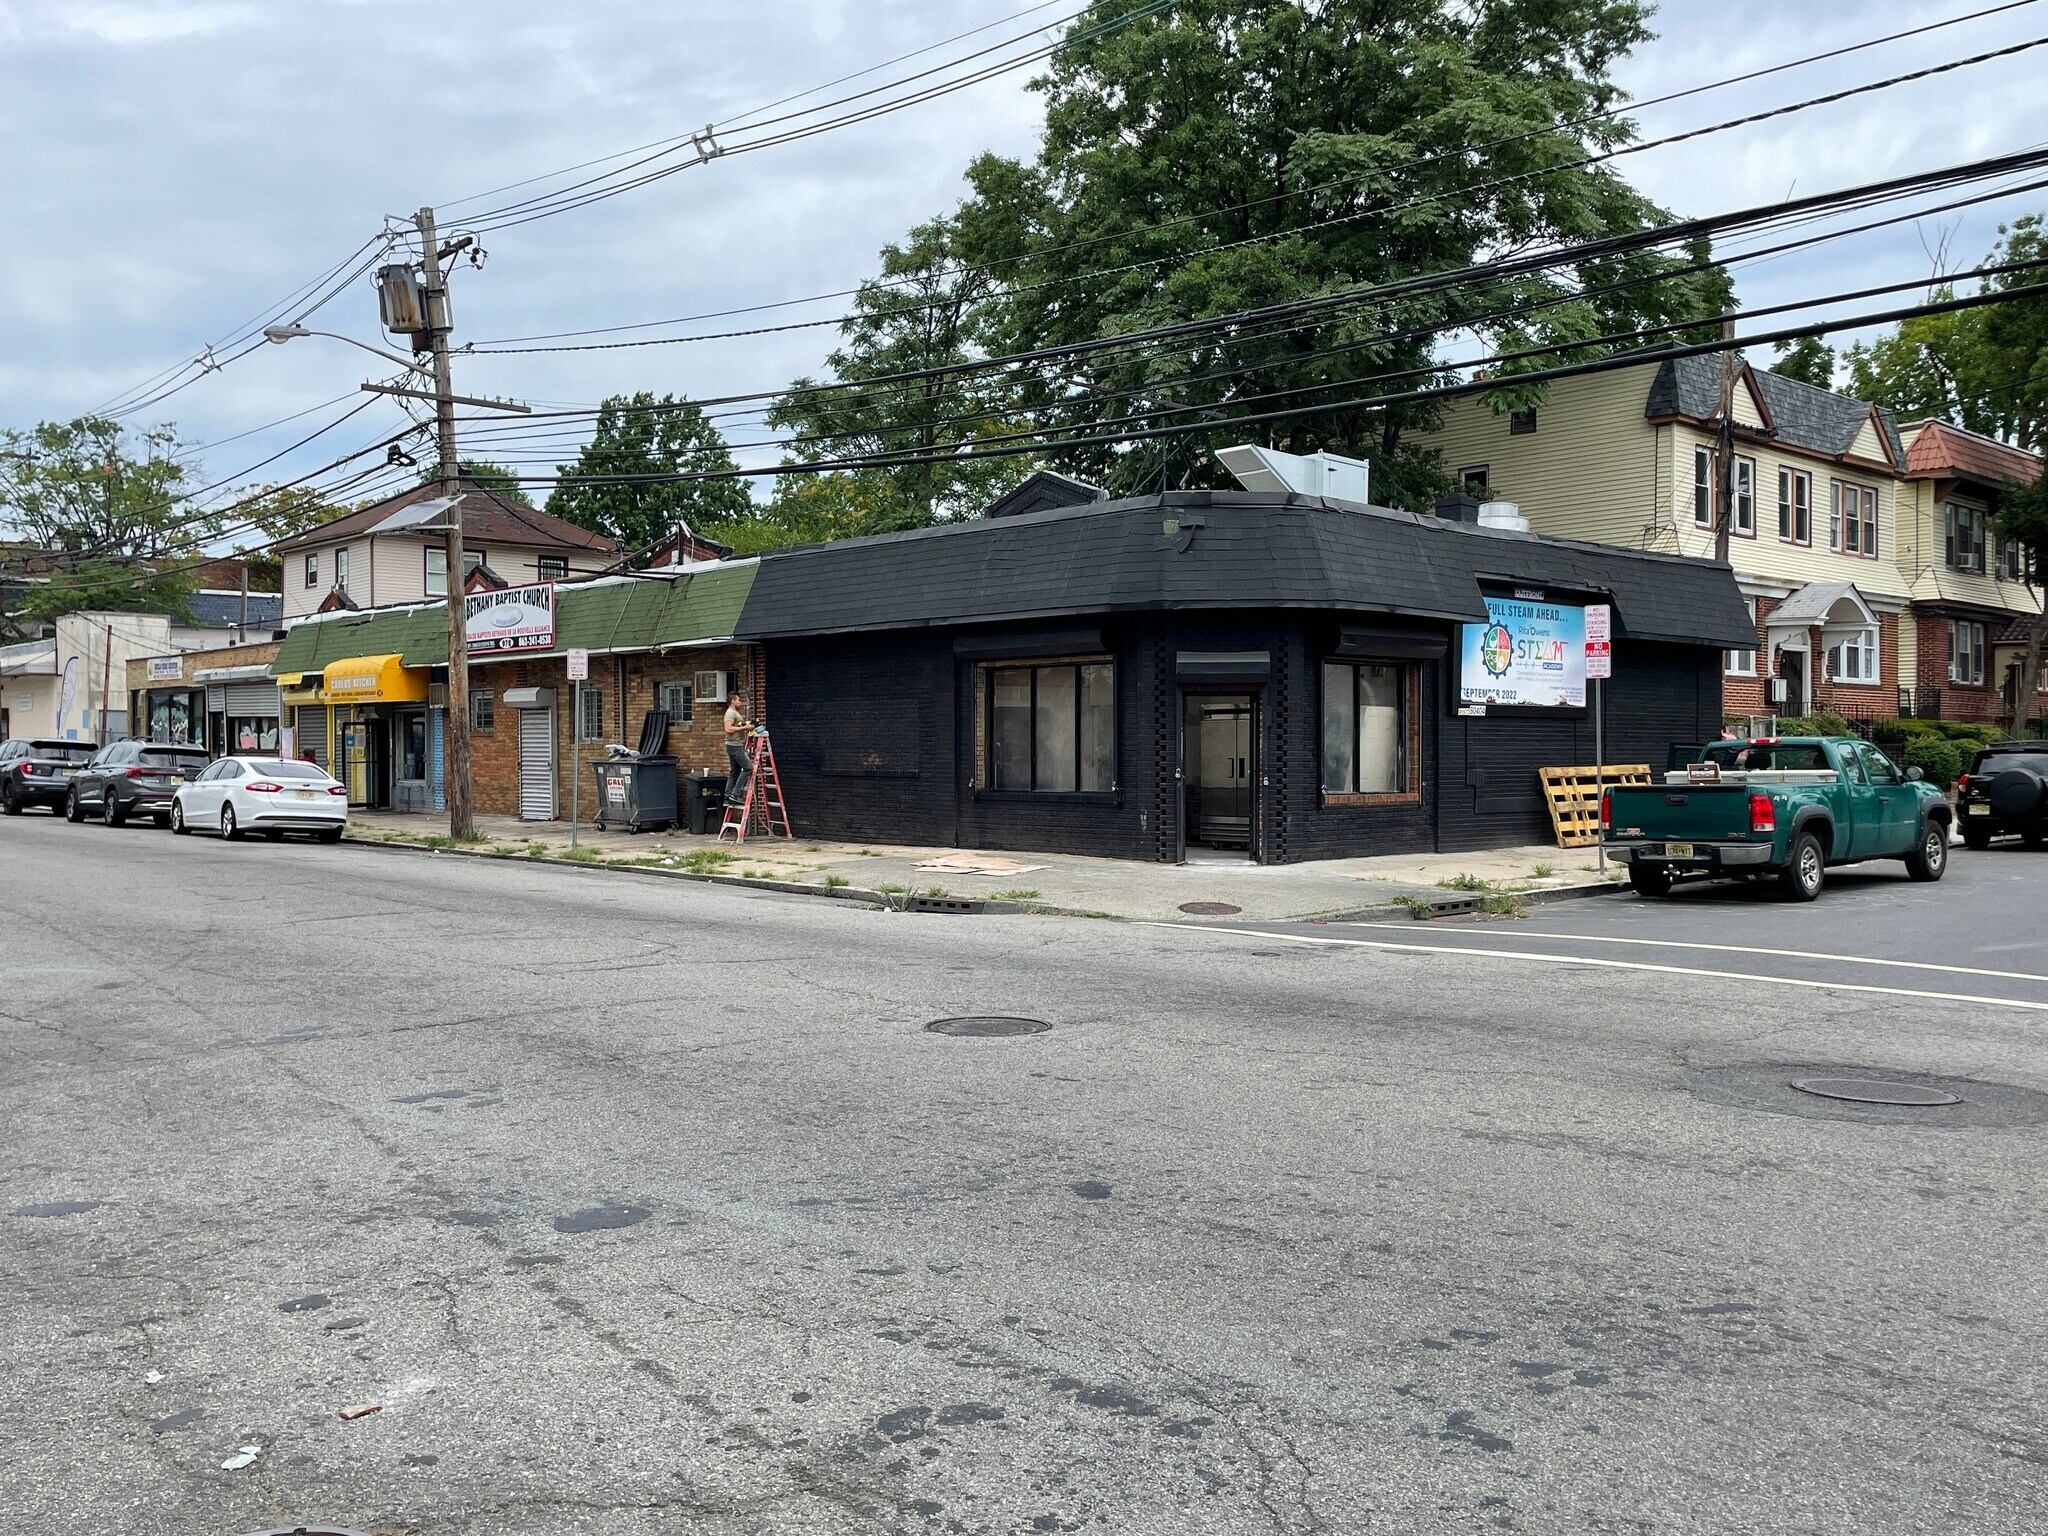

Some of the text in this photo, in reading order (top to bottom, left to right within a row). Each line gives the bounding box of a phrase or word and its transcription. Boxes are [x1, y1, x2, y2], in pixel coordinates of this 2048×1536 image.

[466, 595, 494, 621] BETHANY
[495, 591, 522, 606] BAPTIST
[523, 587, 550, 611] CHURCH
[1487, 603, 1506, 616] FULL
[1508, 605, 1534, 619] STEAM
[1518, 625, 1551, 637] Rita Owens
[331, 677, 376, 690] CARLOS KITCHEN
[1501, 690, 1517, 700] 2022
